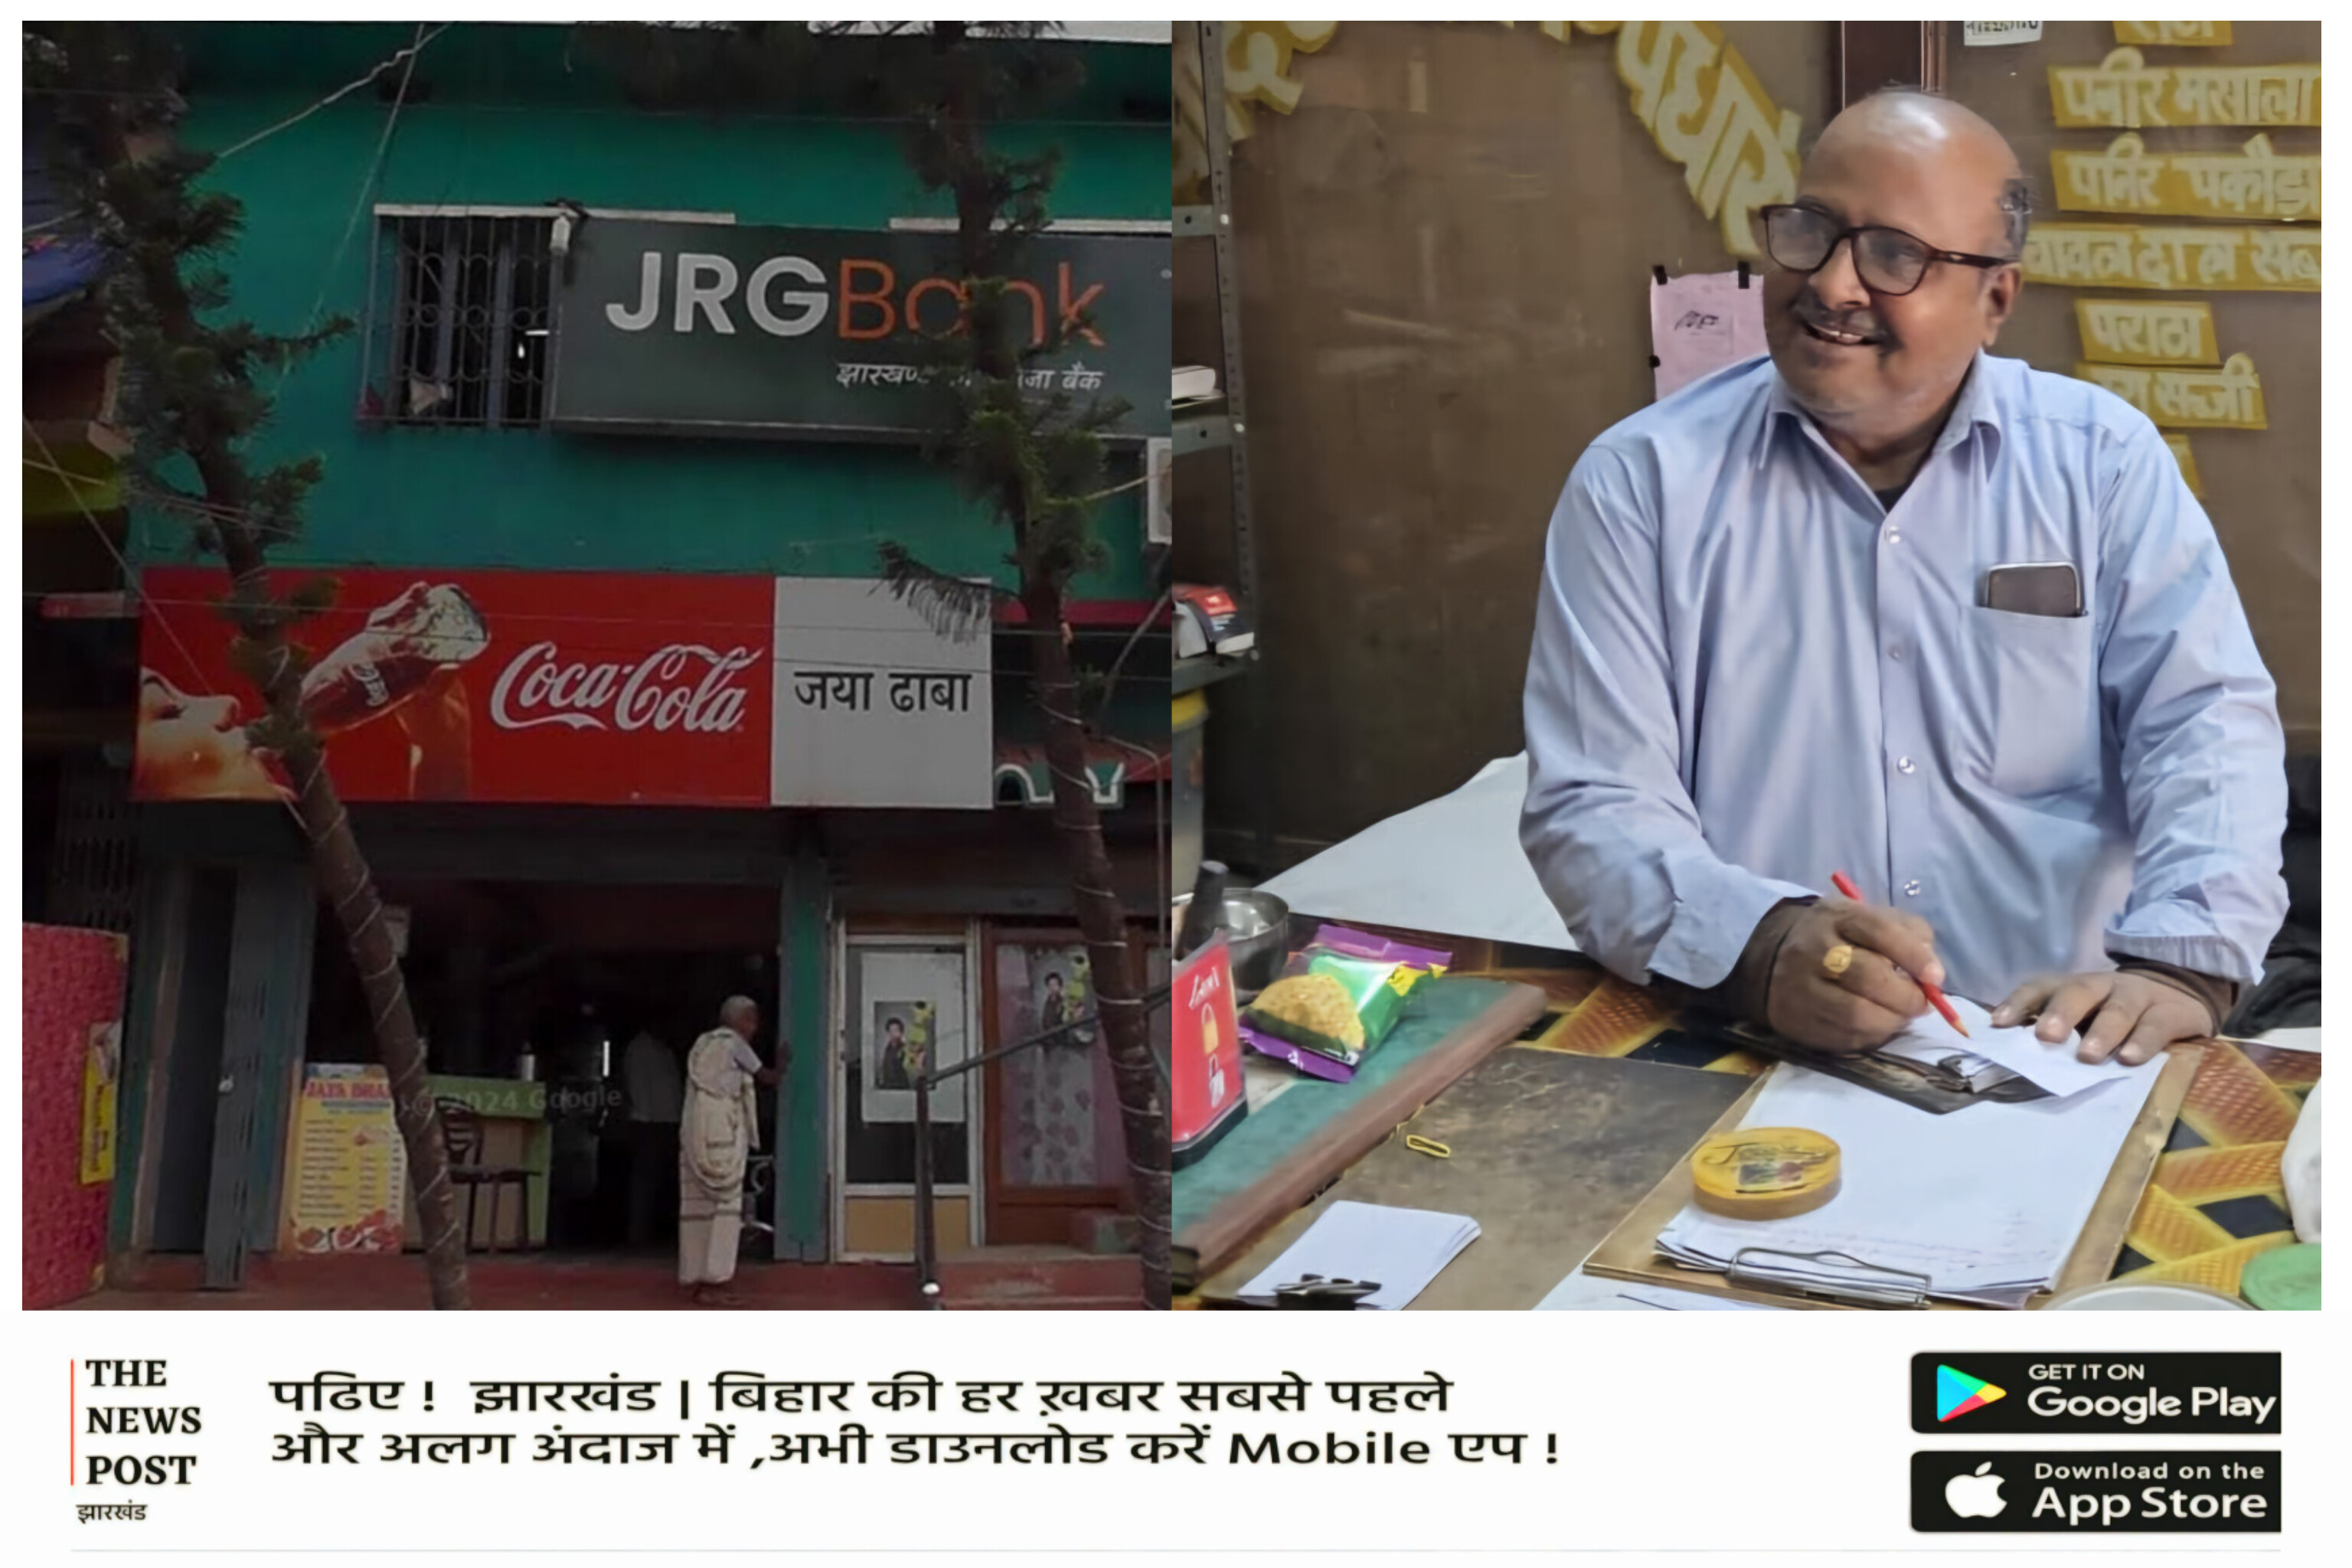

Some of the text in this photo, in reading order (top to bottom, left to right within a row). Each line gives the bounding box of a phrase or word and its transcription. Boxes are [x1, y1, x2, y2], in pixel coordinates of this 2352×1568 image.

[490, 641, 763, 732] Coca-Cola
[793, 672, 972, 713] जया ढाबा
